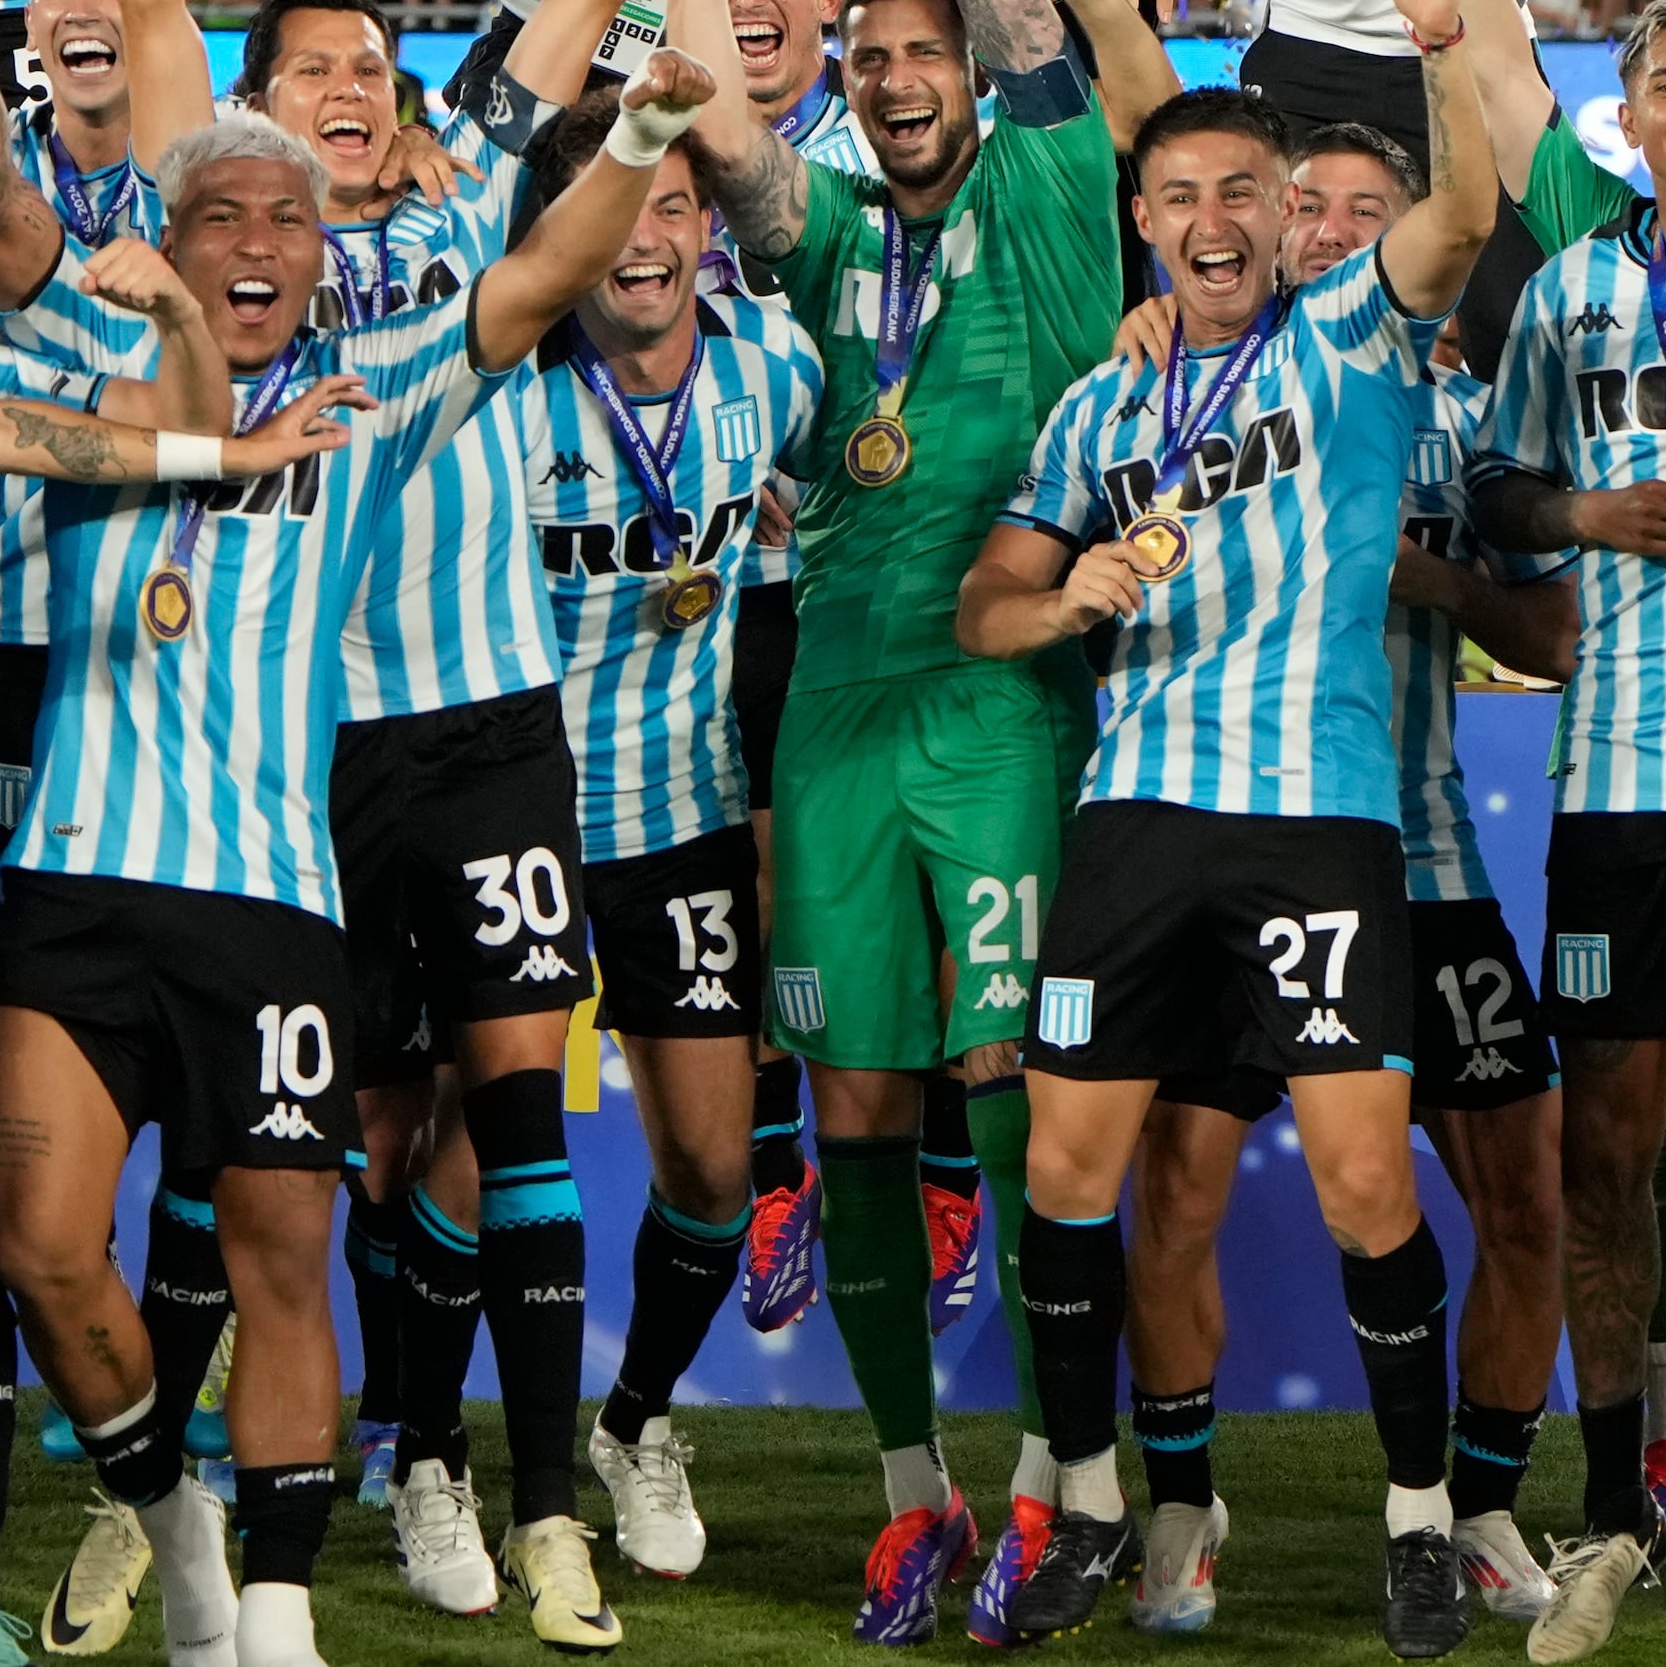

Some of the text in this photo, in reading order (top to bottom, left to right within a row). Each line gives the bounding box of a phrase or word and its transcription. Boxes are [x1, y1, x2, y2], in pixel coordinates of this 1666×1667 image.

[13, 47, 54, 110] 5
[808, 135, 849, 156] RACING
[67, 184, 88, 216] 2024
[886, 255, 902, 344] SUDAMERICANA
[905, 273, 930, 334] CONMEBOL
[1228, 333, 1262, 382] CONMEBOL
[591, 361, 639, 443] SUDAMERICANA
[715, 400, 755, 417] RACING
[462, 847, 570, 947] 30
[966, 874, 1040, 964] 21
[666, 889, 738, 974] 13
[1258, 909, 1361, 1000] 27
[1561, 938, 1604, 949] RACING
[777, 973, 815, 983] RACING
[1046, 983, 1088, 995] RACING
[1435, 957, 1525, 1046] 12
[256, 1003, 334, 1098] 10
